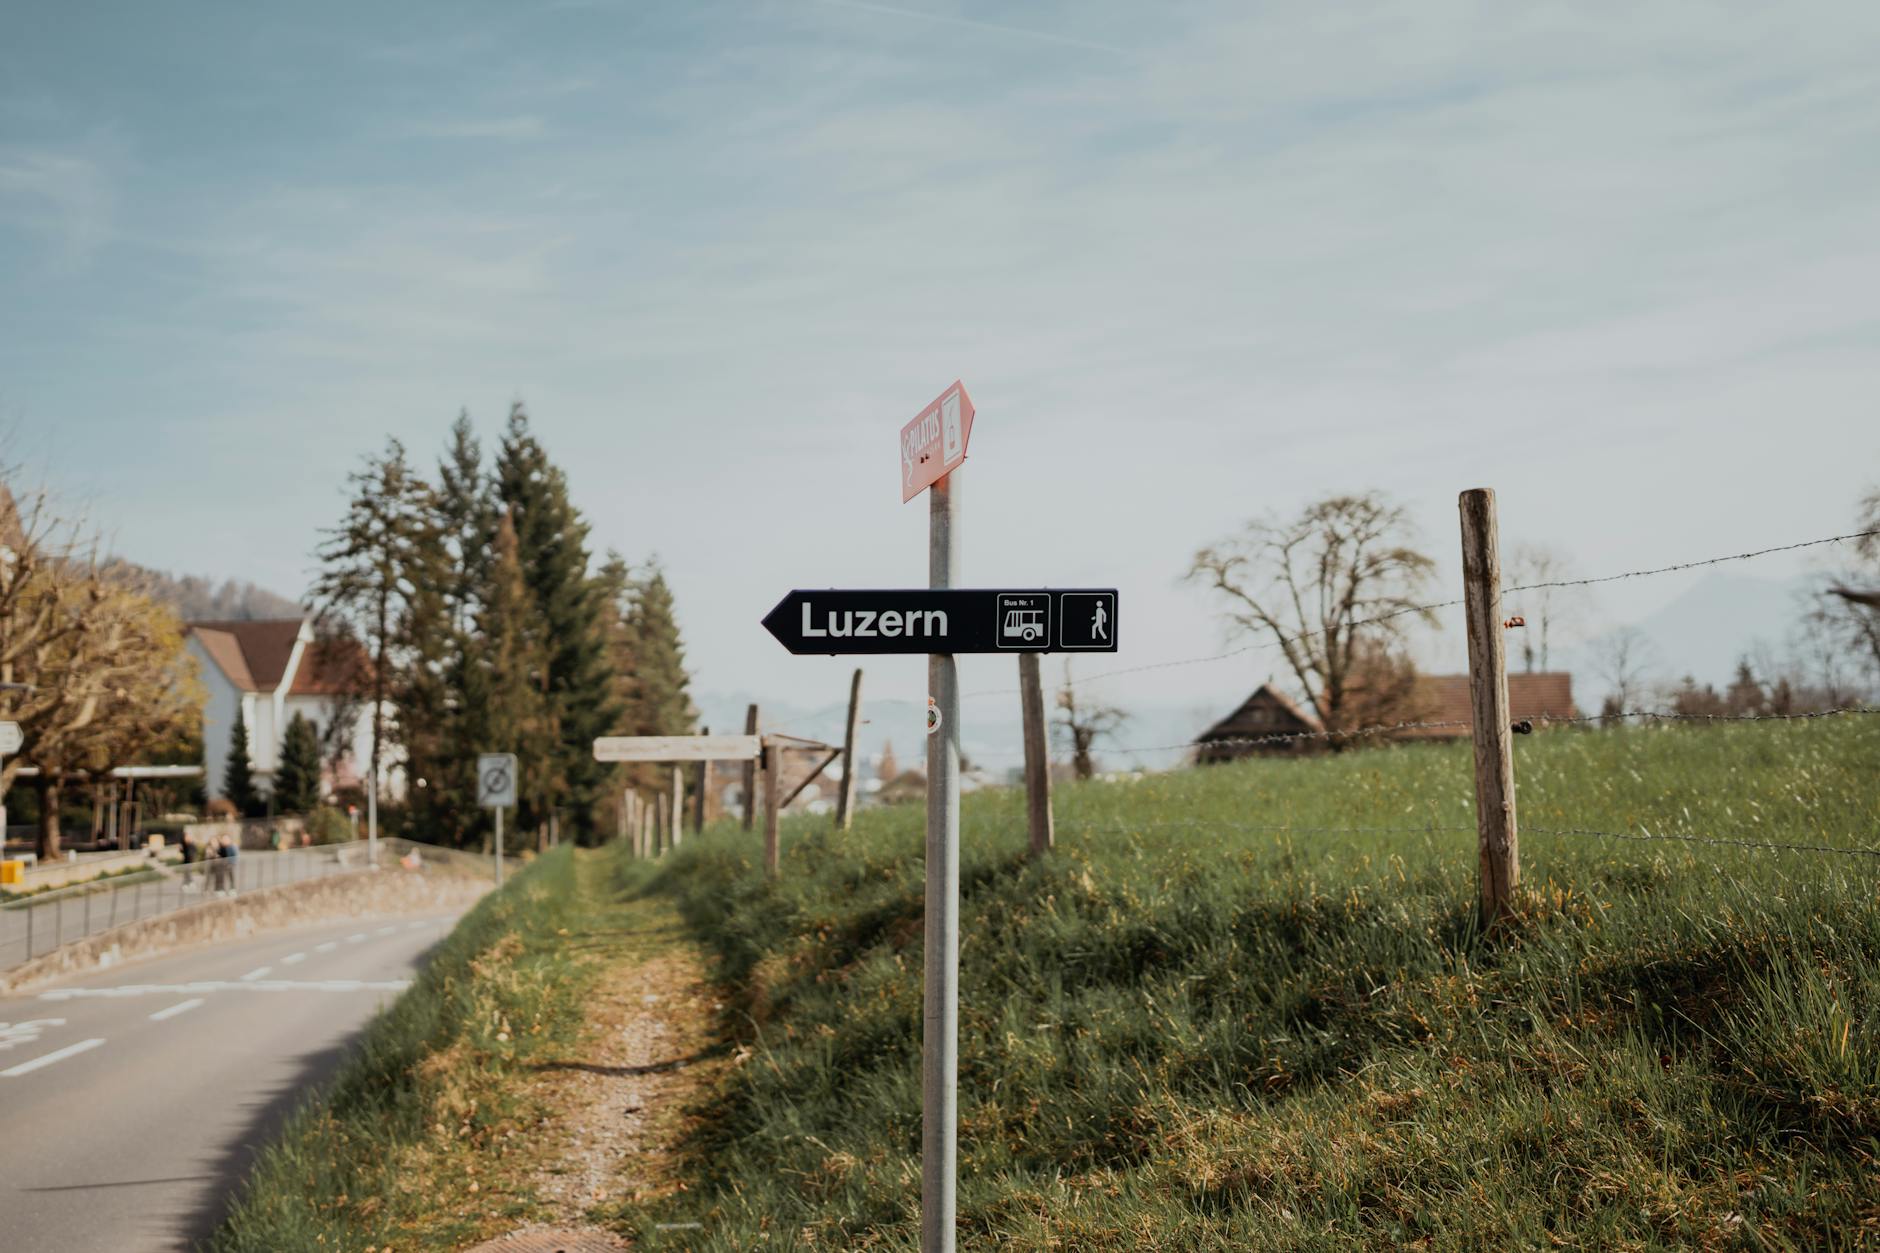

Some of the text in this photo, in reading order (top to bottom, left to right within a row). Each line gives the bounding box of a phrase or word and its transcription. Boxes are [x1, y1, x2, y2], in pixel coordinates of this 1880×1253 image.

[1003, 599, 1018, 607] Bus
[1018, 599, 1029, 607] Nr.
[801, 602, 948, 637] Luzern
